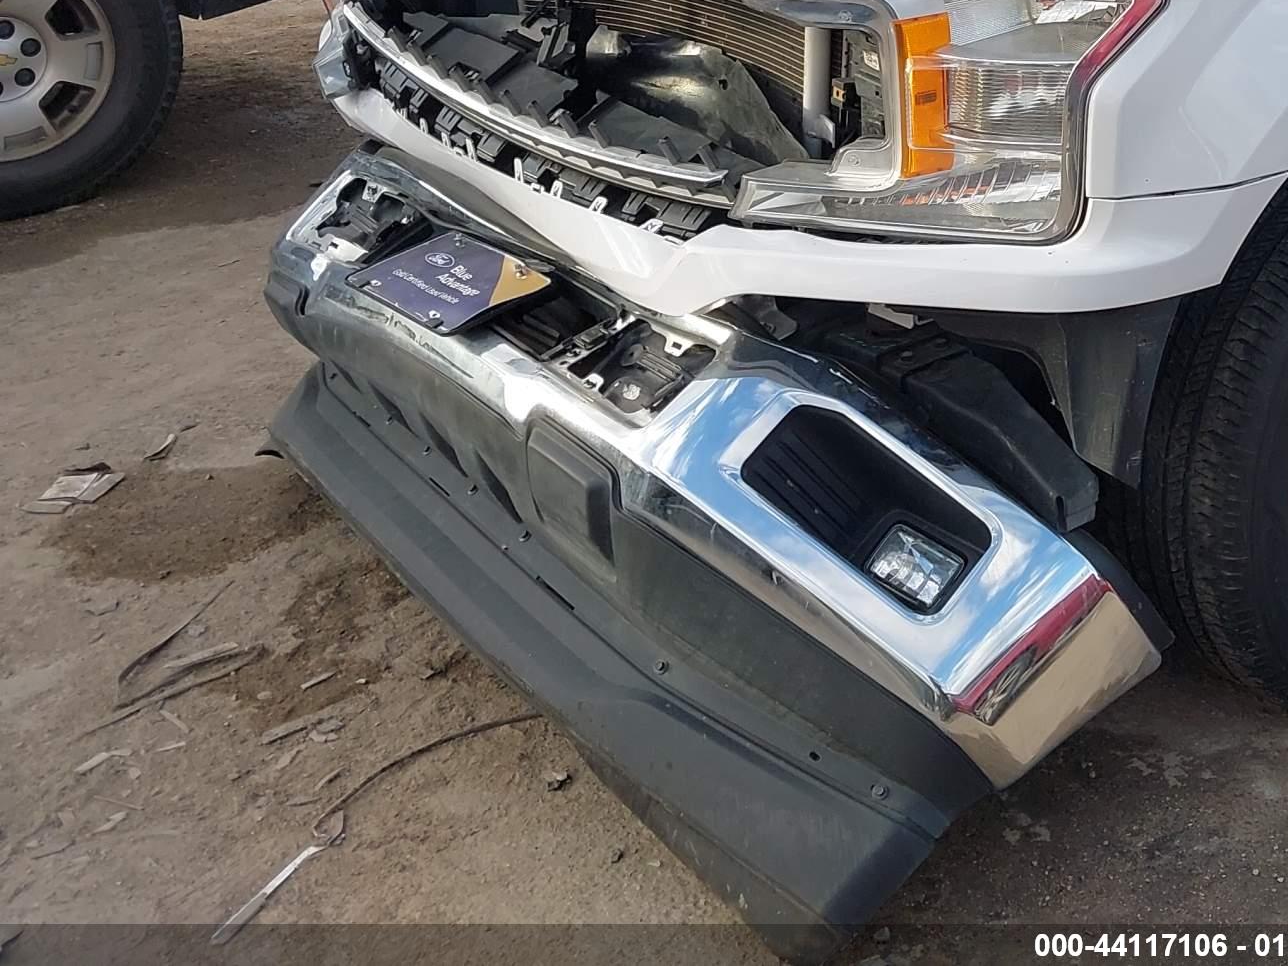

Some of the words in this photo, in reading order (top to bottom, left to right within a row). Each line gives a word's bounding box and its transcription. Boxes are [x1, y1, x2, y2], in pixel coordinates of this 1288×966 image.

[450, 265, 473, 280] Blue
[392, 268, 407, 279] Gold
[404, 273, 428, 290] Certified
[425, 286, 441, 297] Used
[439, 291, 460, 304] Vehicle
[434, 273, 480, 296] Advantage
